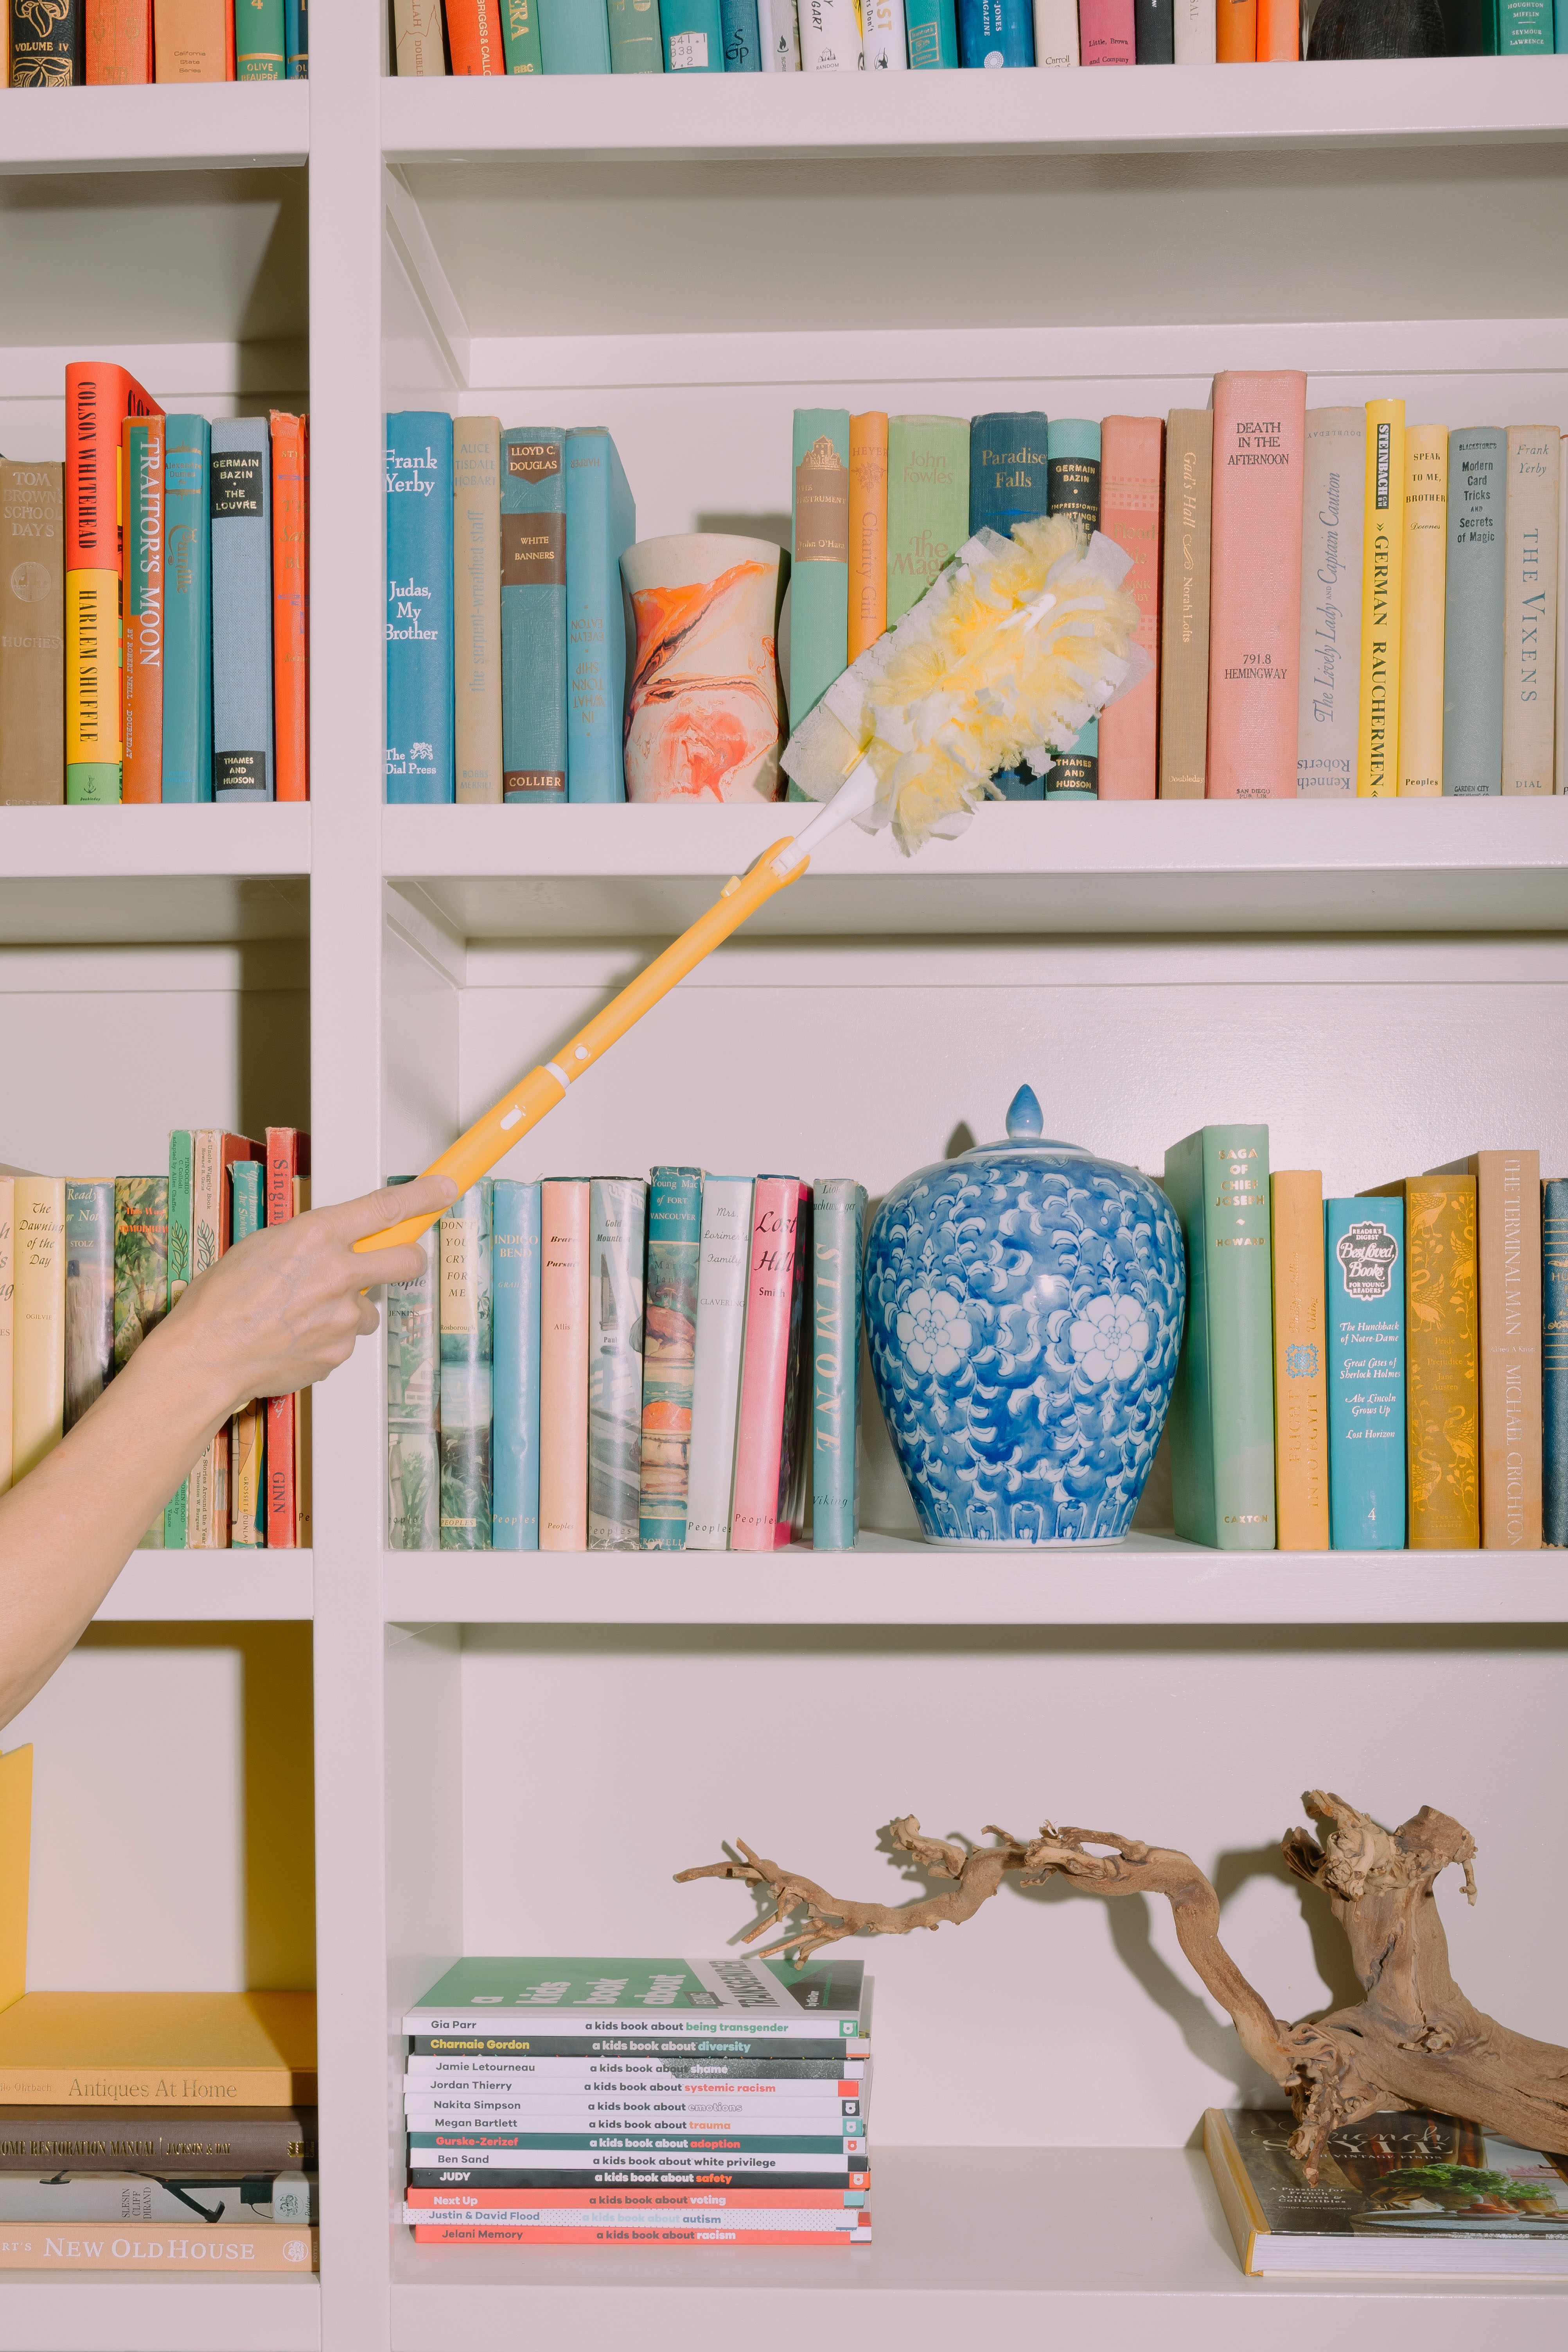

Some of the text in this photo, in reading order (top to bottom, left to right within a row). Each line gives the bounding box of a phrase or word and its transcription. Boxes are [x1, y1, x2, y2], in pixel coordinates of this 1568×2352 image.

[16, 42, 69, 52] VOLUME IV
[248, 63, 273, 72] OLIVE
[671, 57, 693, 68] v.2
[514, 64, 534, 74] BBC
[78, 382, 97, 442] COLSON
[1236, 422, 1281, 434] DEATH
[1238, 436, 1281, 447] IN THE
[511, 446, 555, 456] LLOYD C.
[1517, 444, 1549, 455] Frank
[909, 450, 947, 469] John
[982, 450, 1047, 466] Paradise
[1227, 454, 1289, 465] AFTERNOON
[1377, 424, 1390, 496] STEINBACH
[1413, 452, 1440, 461] SPEAK
[213, 459, 259, 469] GERMAIN
[510, 460, 557, 471] DOUGLAS
[1462, 460, 1493, 472] Modern
[1519, 462, 1547, 477] Yerby
[220, 470, 253, 479] BAZIN
[903, 466, 954, 485] Fowles
[994, 471, 1032, 488] Falls
[1412, 473, 1441, 483] TO ME,
[386, 469, 435, 497] Yerby
[1467, 475, 1487, 486] Card
[225, 489, 245, 498] THE
[1182, 451, 1197, 530] Gad's Hall
[1464, 490, 1491, 501] Tricks
[78, 448, 97, 549] WHITEHEAD
[1406, 494, 1446, 503] BROTHER
[216, 500, 257, 511] LOUVRE
[1459, 517, 1493, 528] Secrets
[520, 536, 549, 545] WHITE
[1457, 531, 1495, 543] of Magic
[139, 437, 161, 667] TRAITOR'S MOON
[515, 551, 555, 560] BANNERS
[389, 577, 432, 601] Judas,
[396, 601, 422, 622] My
[1182, 576, 1193, 644] Norah Lofts
[1520, 528, 1546, 702] THE VIXENS
[1243, 654, 1272, 664] 791.8
[1369, 535, 1389, 788] GERMAN RAUCHERMEN
[79, 589, 98, 742] HARLEM SHUFFLE
[576, 661, 599, 675] SHIP
[1224, 668, 1288, 679] HEMINGWAY
[572, 678, 604, 692] TORN
[572, 694, 605, 709] WHAT
[582, 710, 594, 723] IN
[408, 763, 436, 774] Press
[509, 776, 561, 787] COLLIER
[1405, 777, 1439, 787] Peoples
[1218, 1149, 1258, 1160] SAGA
[1230, 1164, 1248, 1175] OF
[1221, 1180, 1259, 1190] CHIEF
[657, 1194, 665, 1206] of
[1214, 1195, 1265, 1207] JOSEPH
[32, 1203, 51, 1214] The
[650, 1212, 696, 1221] VANCOUVER
[755, 1210, 797, 1233] Lost
[19, 1219, 65, 1233] Dawning
[27, 1237, 55, 1250] of the
[1216, 1237, 1266, 1247] HOWARD
[1504, 1159, 1521, 1336] THE TERMINAL MAN
[29, 1253, 52, 1268] Day
[445, 1254, 467, 1264] CRY
[753, 1250, 794, 1272] Hill
[447, 1271, 468, 1280] FOR
[1349, 1262, 1385, 1281] Books
[448, 1288, 466, 1297] ME
[1340, 1320, 1399, 1331] The Hunchback
[1340, 1333, 1399, 1345] of Notre-Dame
[815, 1242, 841, 1454] SIMONE
[1505, 1364, 1522, 1446] MICHAEL
[1345, 1429, 1395, 1439] Lost Horizon
[272, 1471, 286, 1514] GINN
[1224, 1514, 1269, 1523] CAXTON
[1367, 1507, 1376, 1521] 4
[431, 2020, 477, 2029] Gia Parr
[595, 2021, 618, 2030] kids
[621, 2021, 648, 2031] book
[650, 2022, 683, 2031] about
[686, 2022, 717, 2033] being
[719, 2023, 788, 2034] transgender
[430, 2039, 530, 2050] Charnaie Gordon
[698, 2041, 751, 2053] diversity
[68, 2078, 237, 2101] Antiques At Home
[430, 2081, 512, 2092] Jordan Thierry
[684, 2083, 776, 2093] systemic racism
[689, 2121, 731, 2129] trauma
[436, 2137, 519, 2147] Gurske-Zerizef
[30, 2140, 231, 2156] RESTORATION MANUAL JACKSON & DAY
[439, 2172, 471, 2181] JUDY
[696, 2173, 732, 2184] safety
[121, 2188, 130, 2218] SLESIN
[132, 2190, 141, 2216] CLIFF
[143, 2187, 152, 2219] DIRAND
[434, 2196, 478, 2207] Next Up
[43, 2237, 255, 2260] NEW OLD HOUSE
